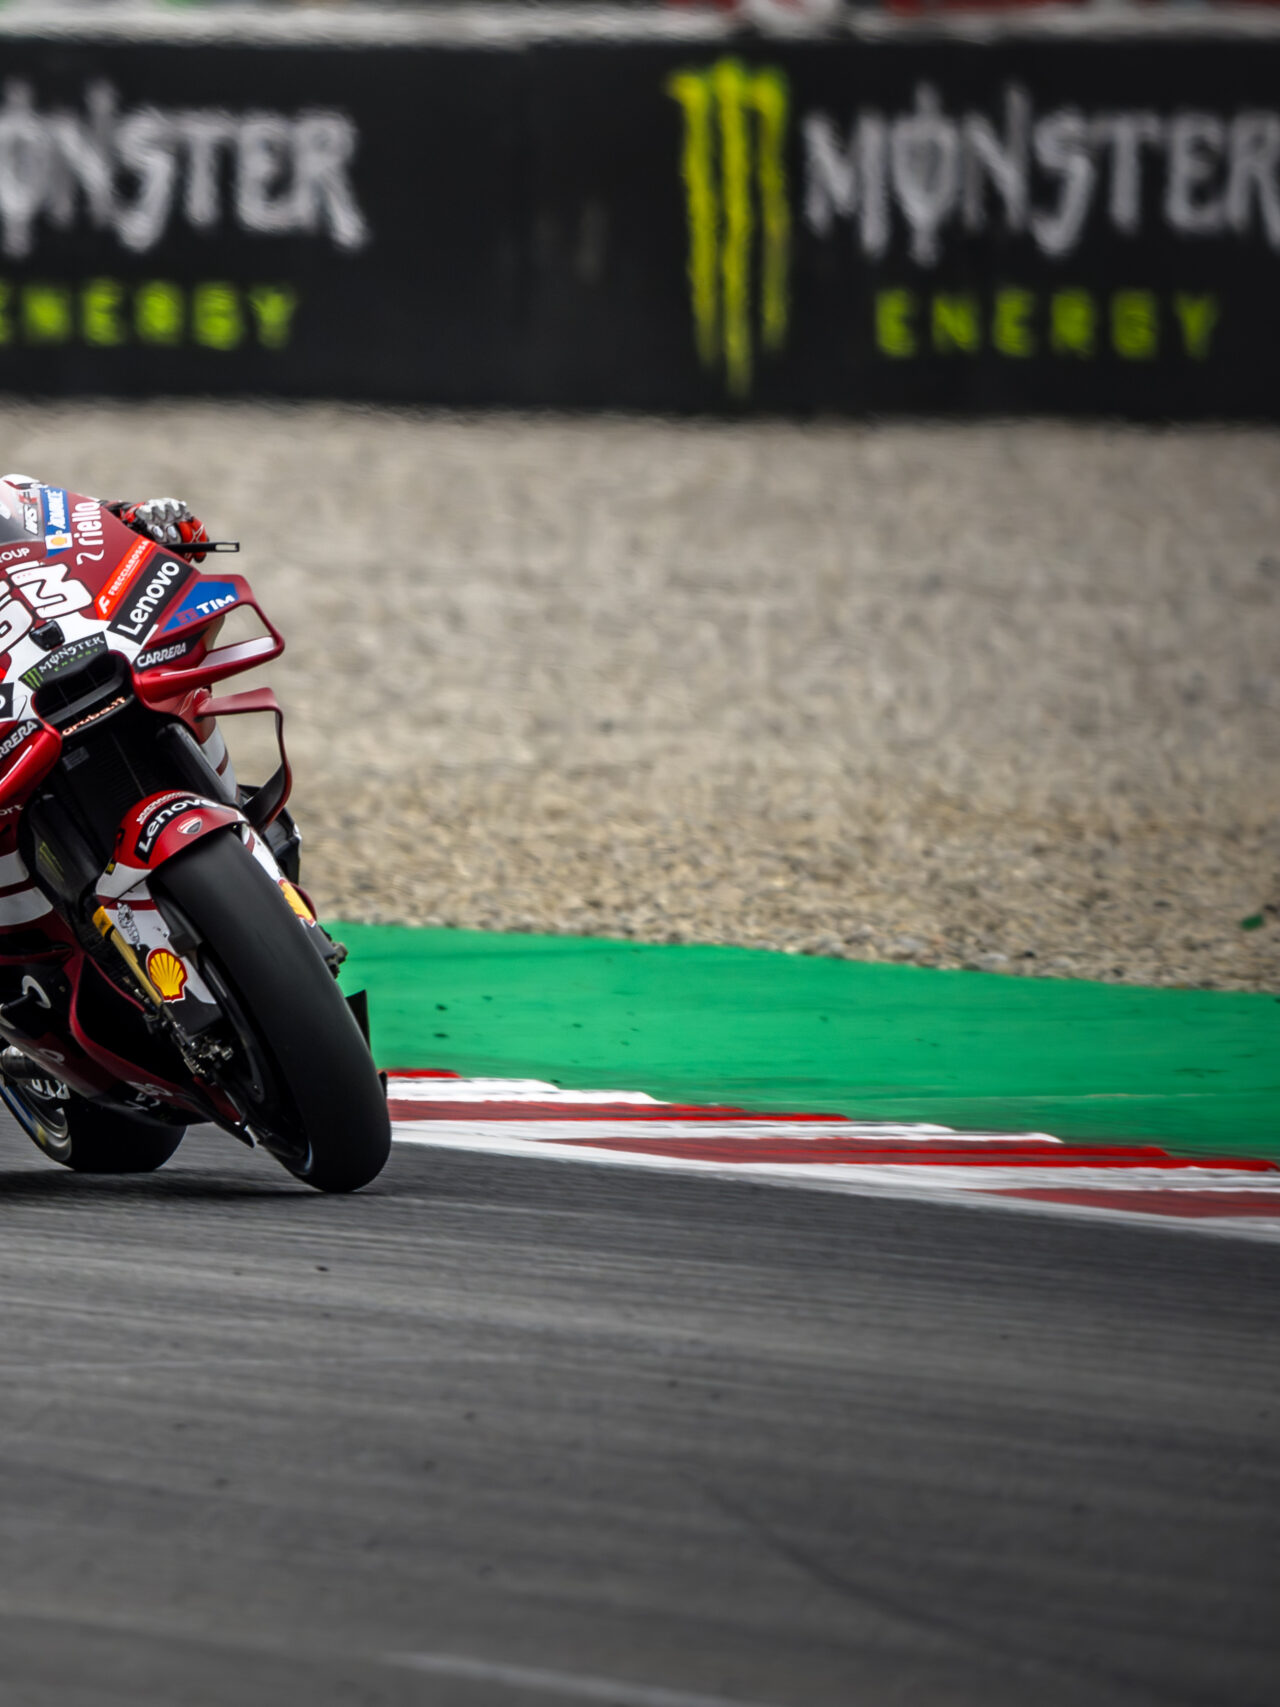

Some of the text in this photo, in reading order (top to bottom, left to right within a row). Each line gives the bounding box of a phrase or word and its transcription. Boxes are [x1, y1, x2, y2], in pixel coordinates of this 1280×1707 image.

[804, 80, 1280, 266] MONSTER
[875, 290, 1216, 360] ENERGY
[71, 501, 103, 546] riello
[108, 539, 150, 596] FRECCIAROSSA
[117, 561, 180, 636] Lenovo
[196, 594, 236, 614] TIM
[38, 636, 105, 674] MONSTER
[136, 642, 187, 668] CARRERA
[138, 798, 219, 853] Lenovo
